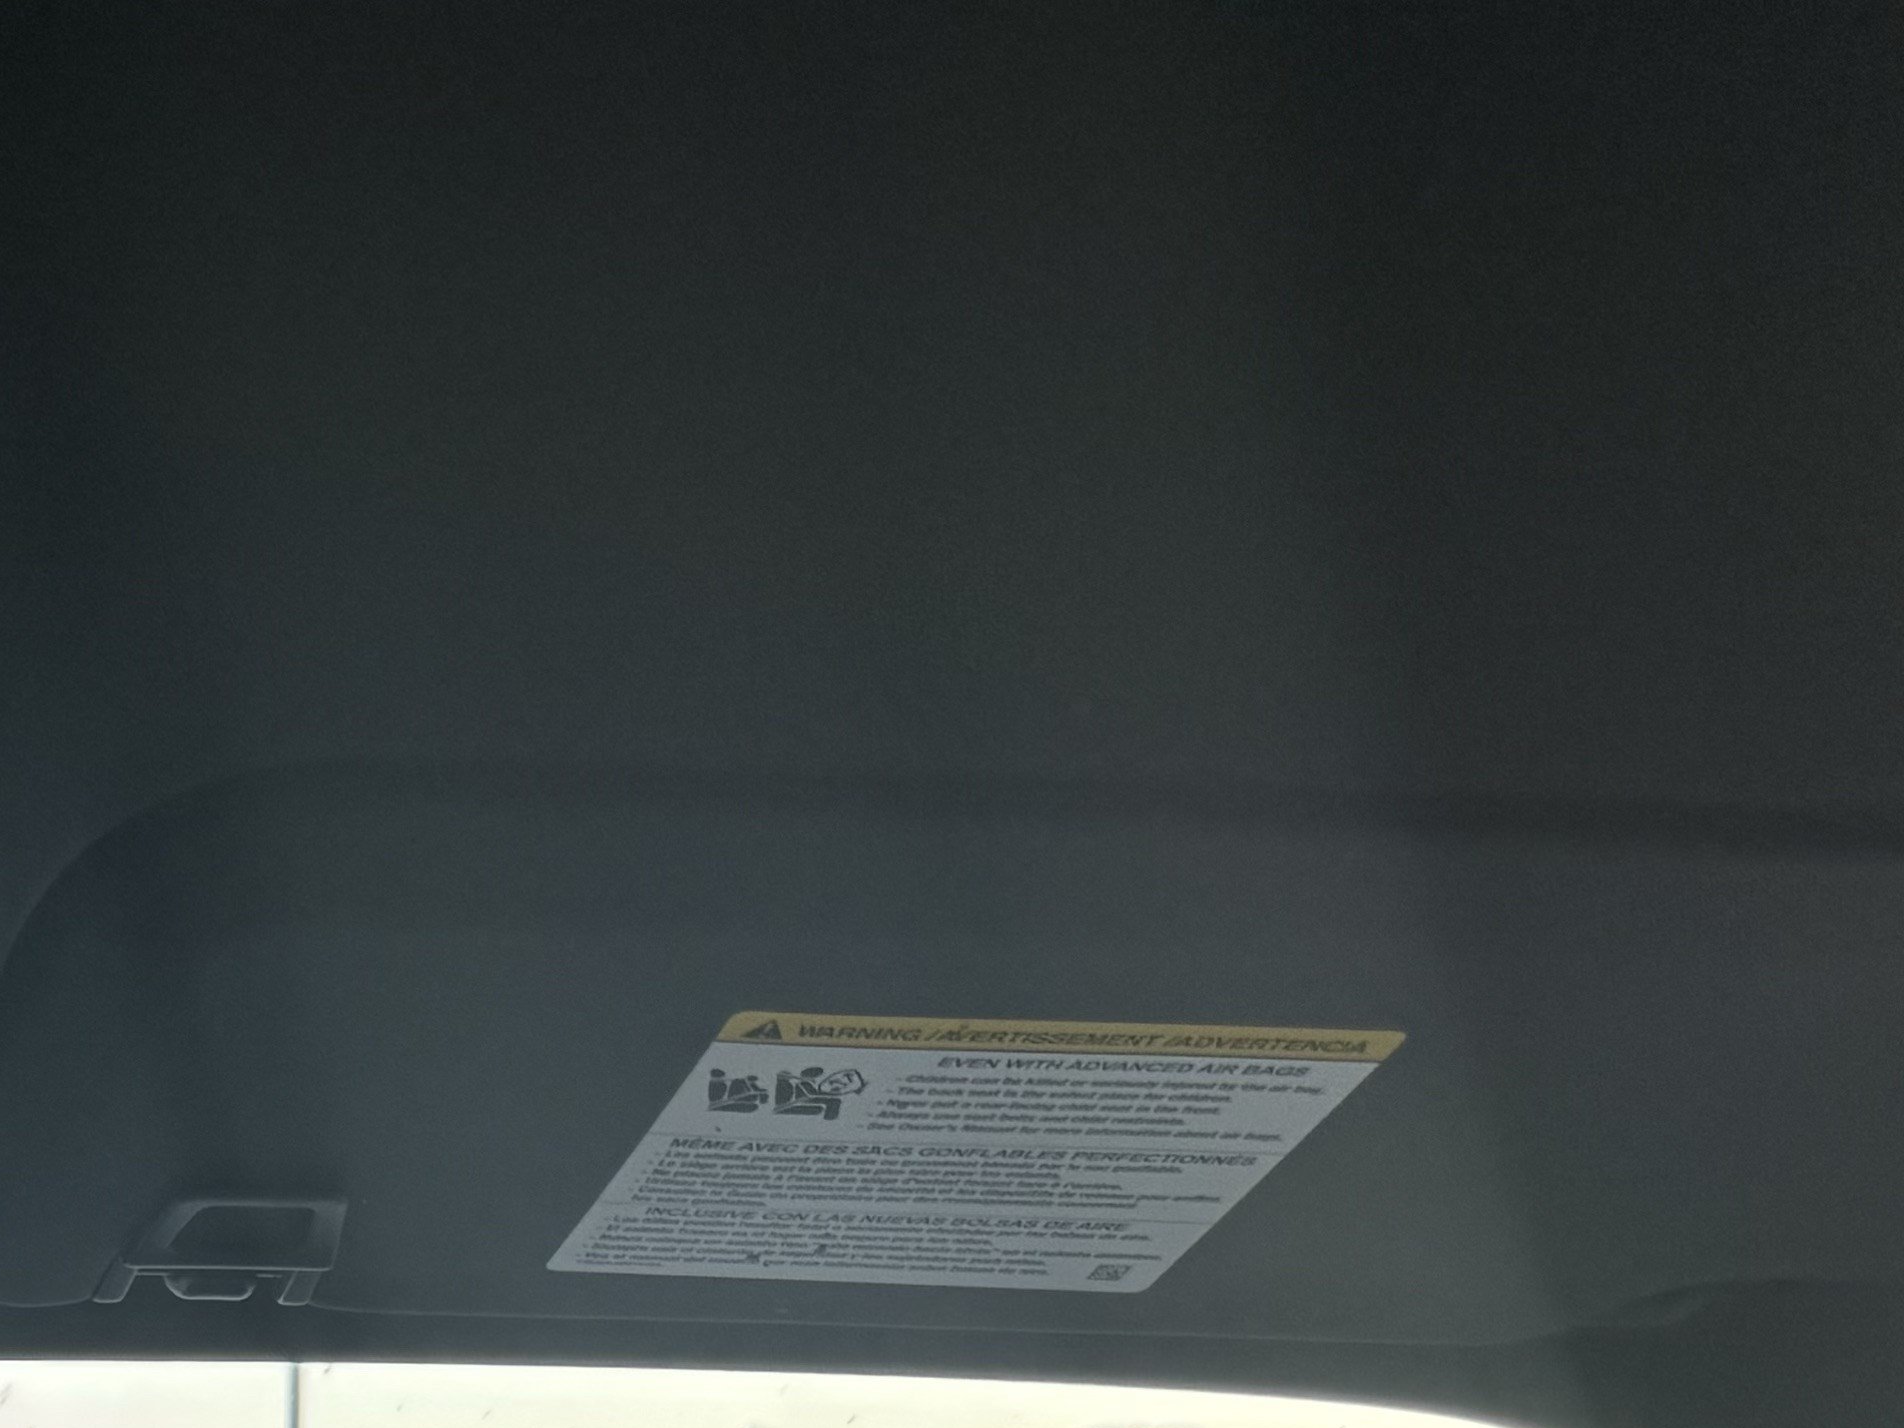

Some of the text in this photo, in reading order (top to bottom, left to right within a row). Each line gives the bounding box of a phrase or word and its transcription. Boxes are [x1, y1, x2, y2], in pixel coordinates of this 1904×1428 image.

[798, 1024, 923, 1041] WARNING
[936, 1056, 1312, 1077] EVEN WITH ADVANCED AIR BAGS
[738, 1141, 800, 1154] AVEC
[803, 1143, 851, 1155] DES
[761, 1211, 810, 1222] CON
